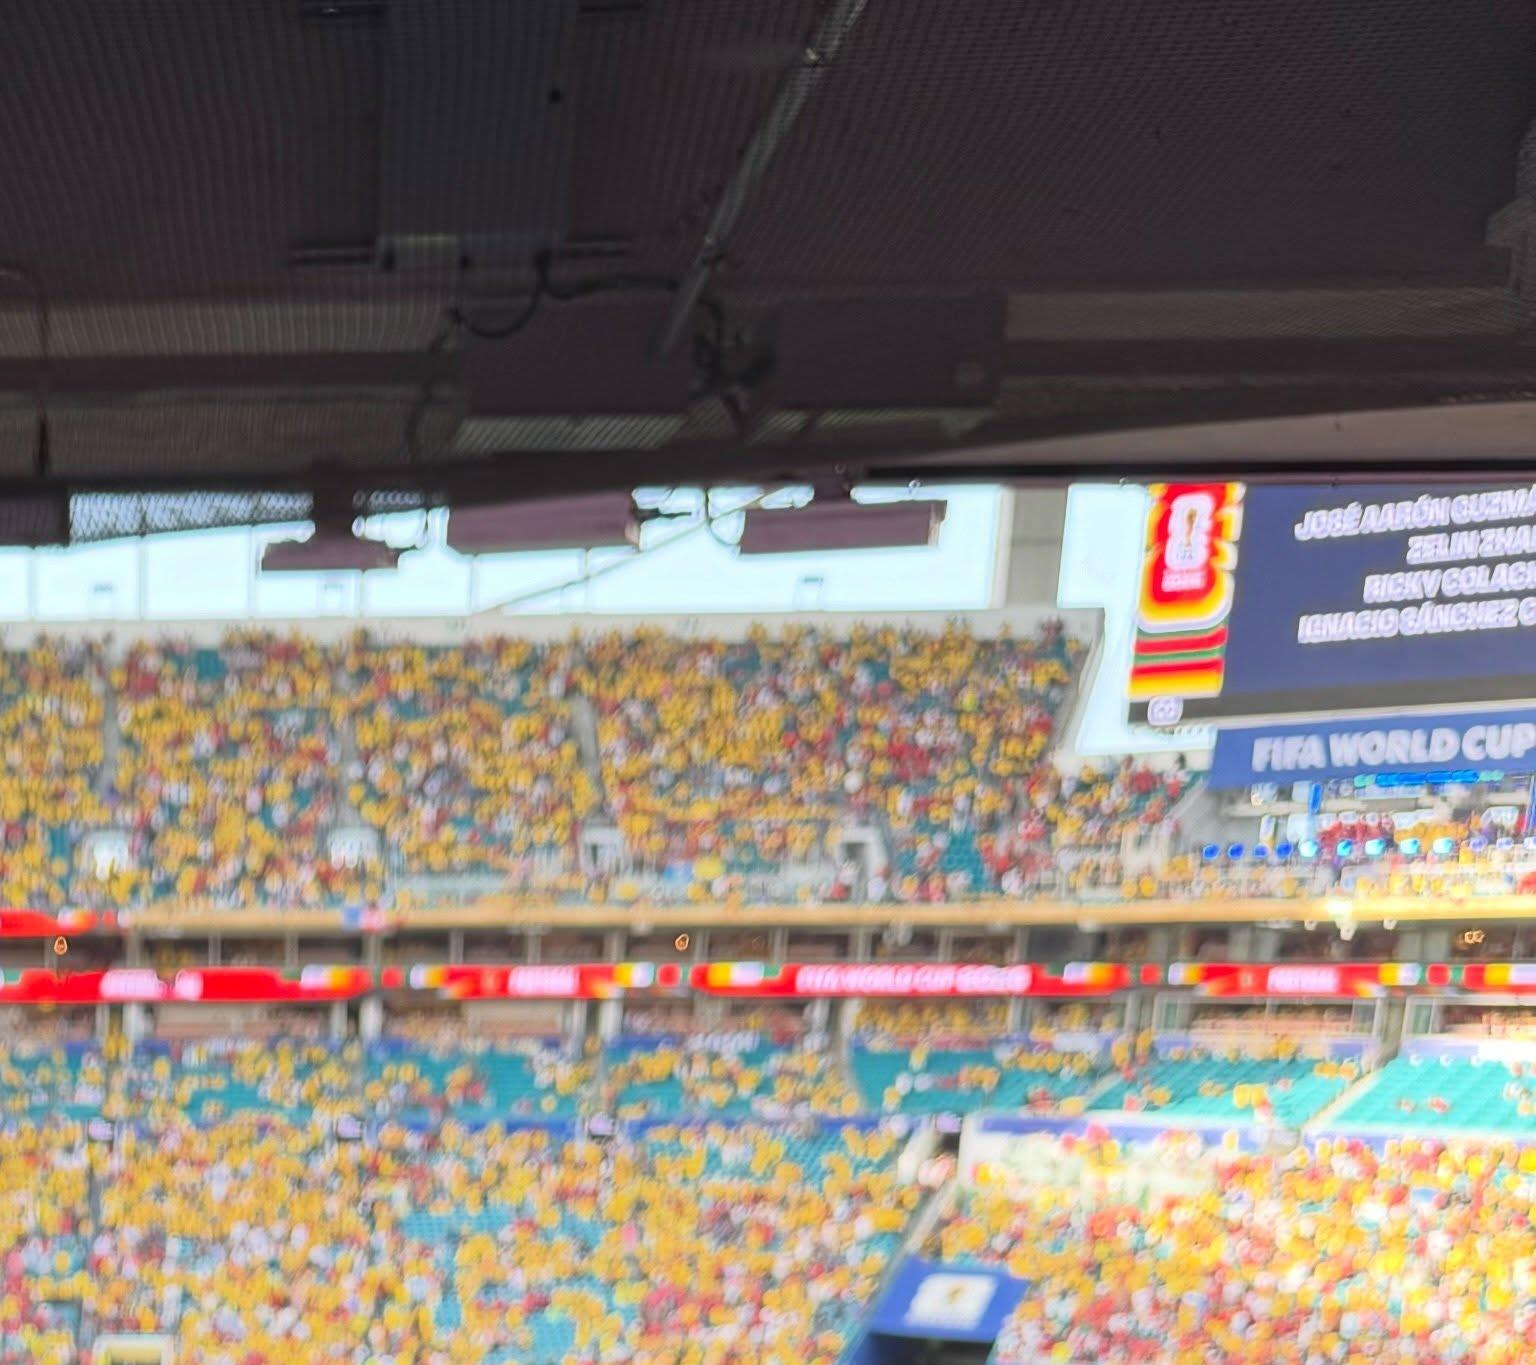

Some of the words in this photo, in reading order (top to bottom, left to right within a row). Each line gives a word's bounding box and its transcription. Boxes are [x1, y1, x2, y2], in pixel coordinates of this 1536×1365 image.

[1252, 735, 1327, 773] FIFA
[1329, 727, 1460, 768] WORLD
[1463, 722, 1536, 762] CUP
